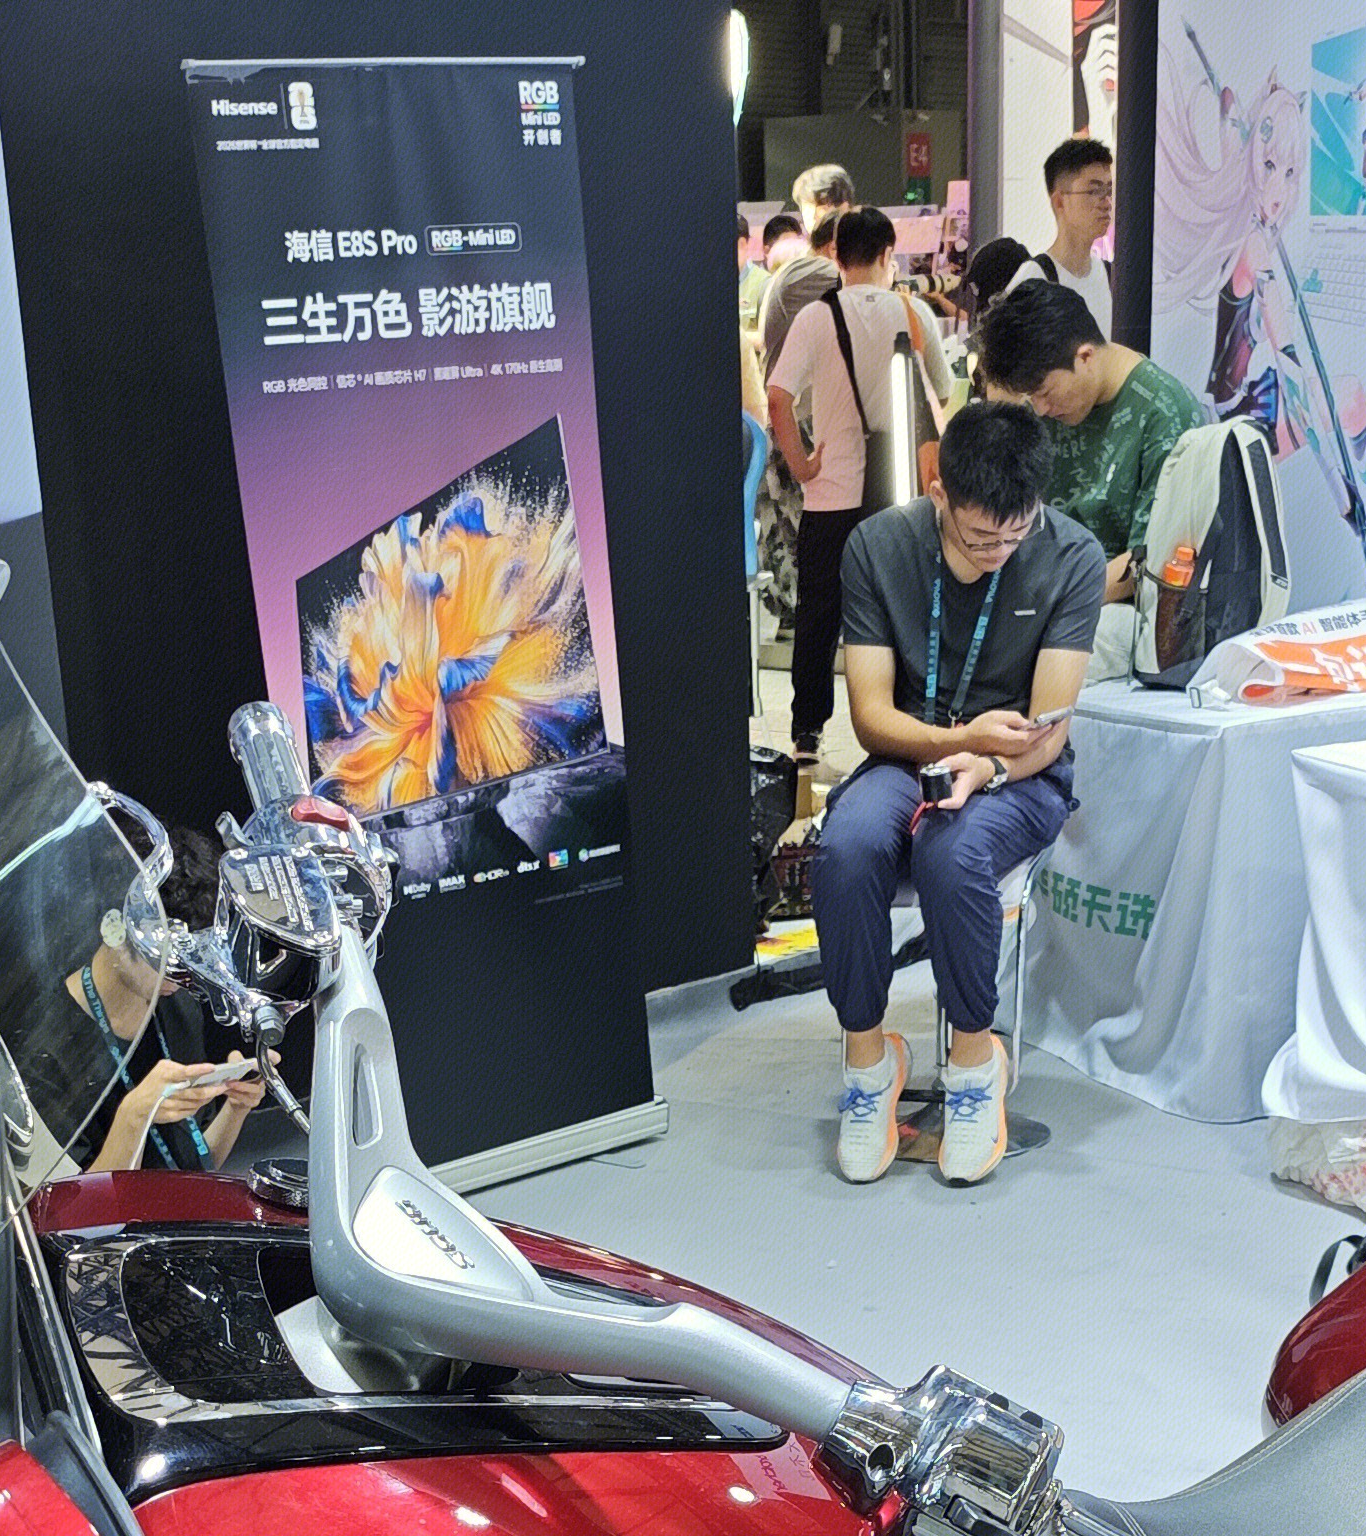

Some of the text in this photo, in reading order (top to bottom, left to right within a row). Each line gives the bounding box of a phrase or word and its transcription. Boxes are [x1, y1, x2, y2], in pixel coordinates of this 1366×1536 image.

[518, 81, 559, 104] RGB
[211, 99, 278, 116] Hisense
[285, 230, 333, 263] 海信
[338, 231, 376, 260] E8S
[382, 228, 417, 257] Pro
[495, 228, 516, 246] LED
[261, 281, 556, 346] 三生万色 影游旗舰
[262, 380, 285, 393] RGB
[1302, 621, 1318, 636] AI
